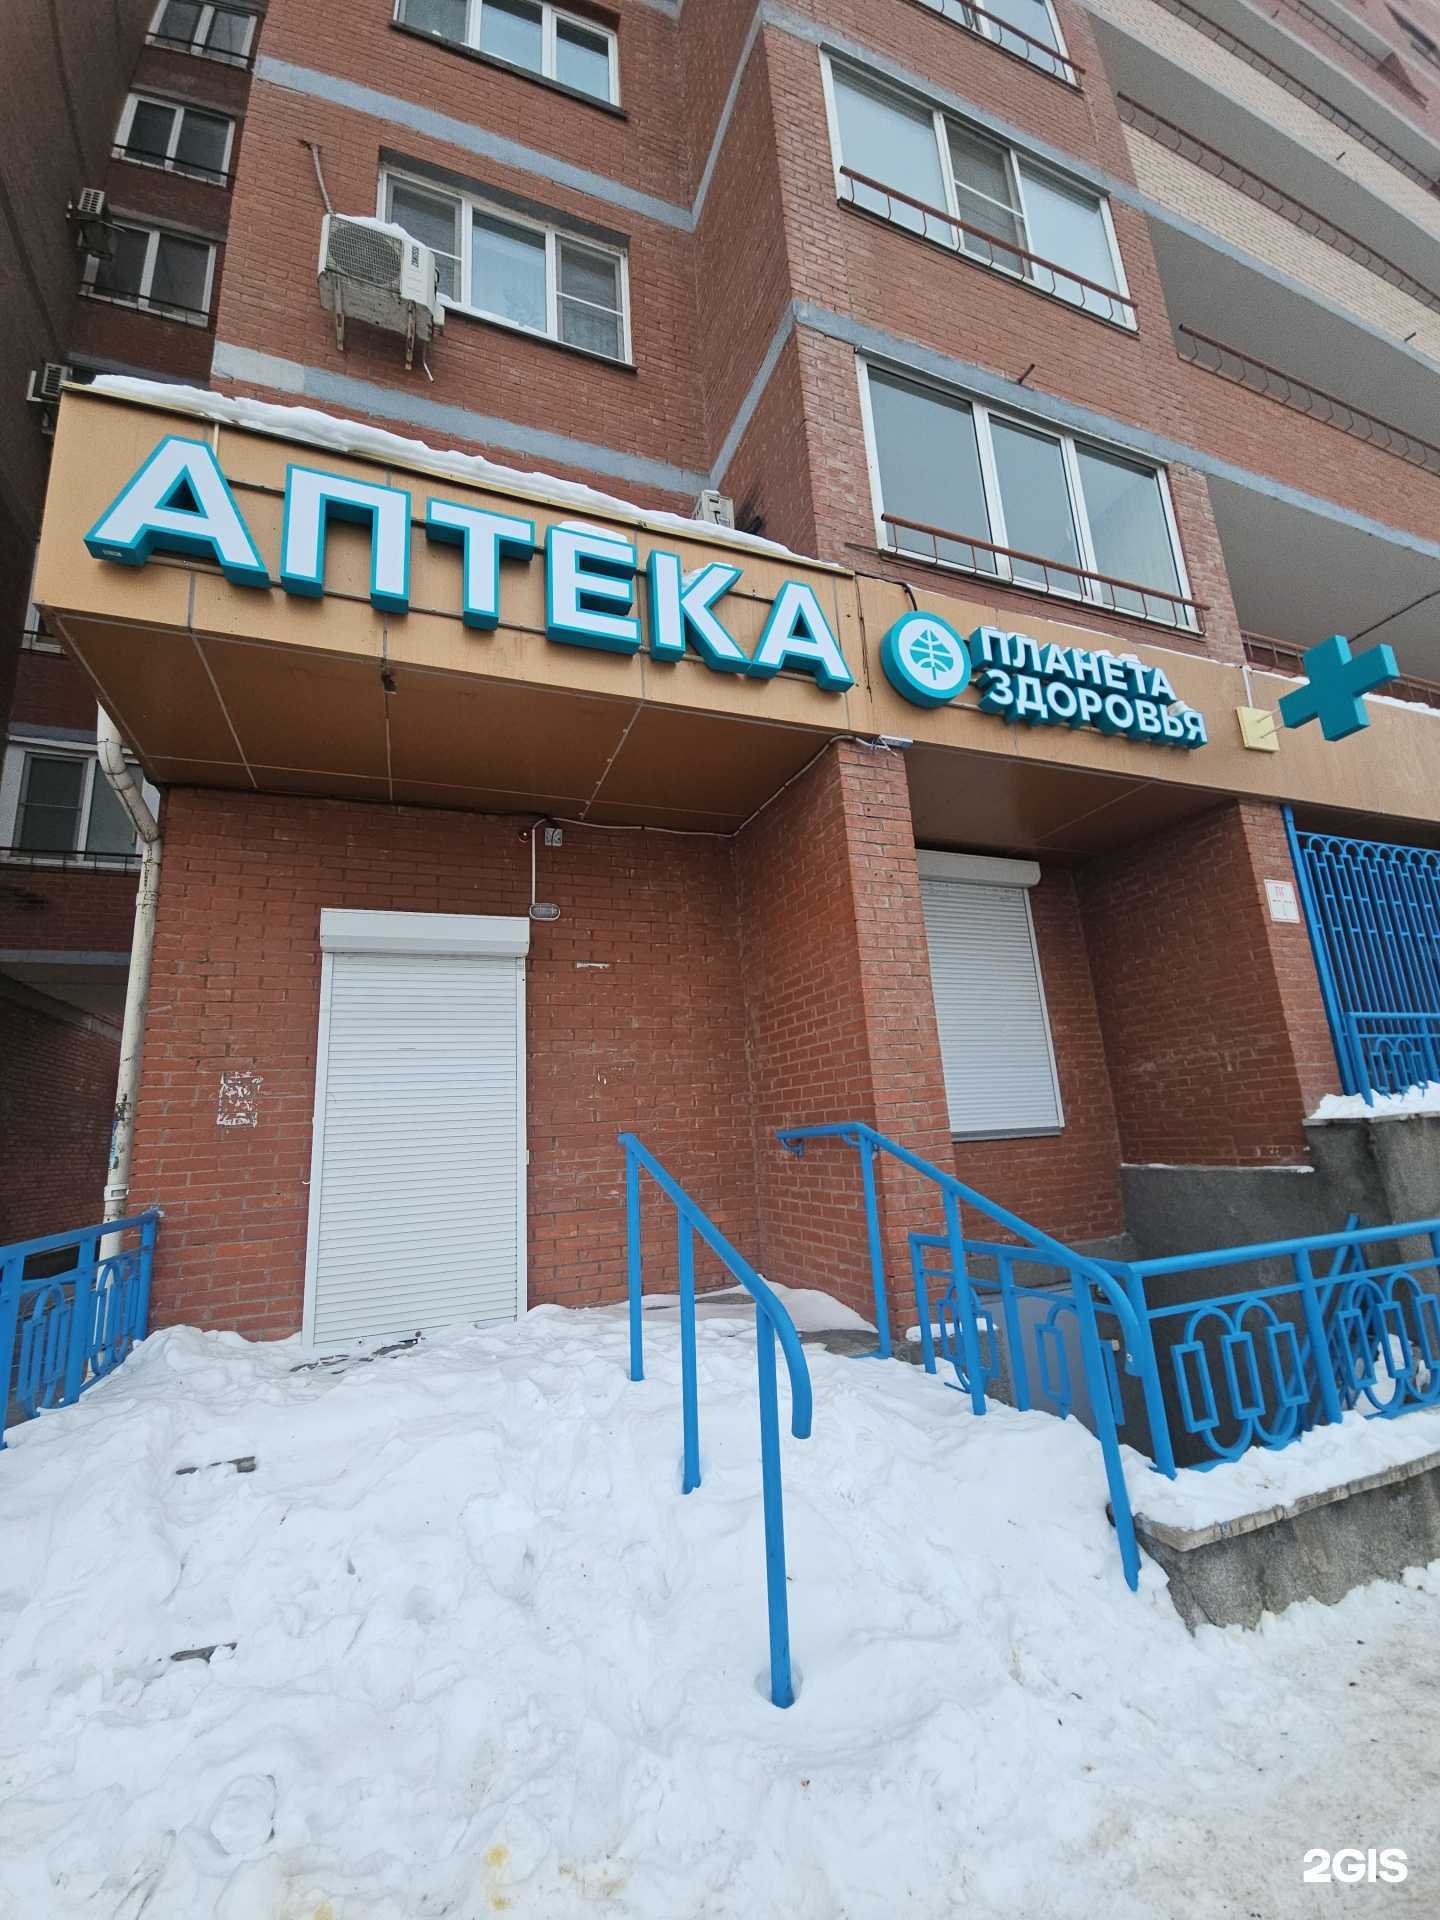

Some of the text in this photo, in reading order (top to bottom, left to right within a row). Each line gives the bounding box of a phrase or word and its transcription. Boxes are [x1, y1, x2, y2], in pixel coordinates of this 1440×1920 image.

[84, 436, 854, 693] АПТЕКА
[975, 627, 1178, 701] ПЛАНЕТА
[984, 669, 1209, 746] ЗДОРОВЬЯ
